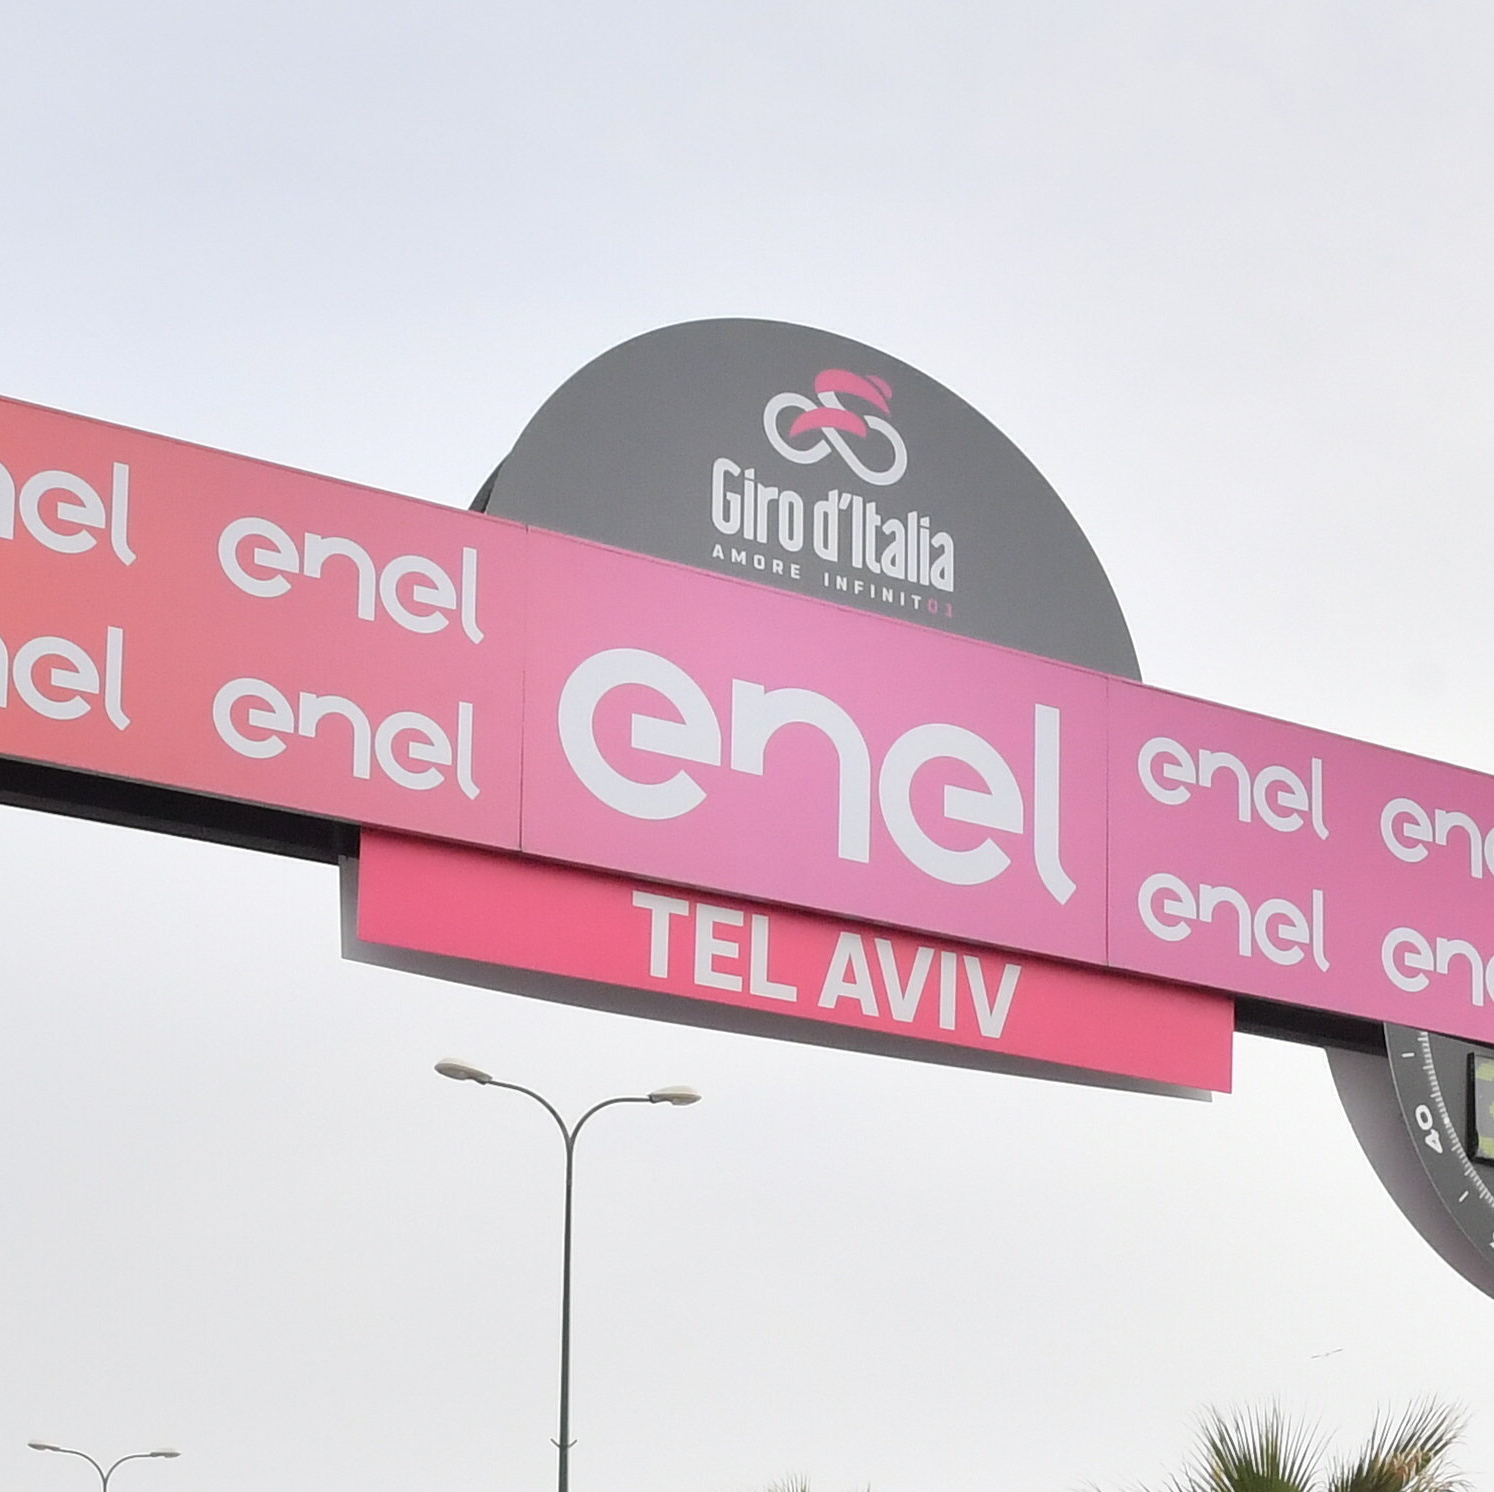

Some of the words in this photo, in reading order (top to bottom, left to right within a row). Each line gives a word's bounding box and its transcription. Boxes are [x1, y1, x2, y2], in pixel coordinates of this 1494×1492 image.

[712, 458, 804, 552] Giro
[219, 516, 485, 645] enel
[712, 543, 801, 580] AMORE
[212, 677, 481, 801] enel
[558, 647, 1077, 906] enel
[1138, 737, 1330, 840] enel
[632, 892, 797, 1002] TEL
[818, 933, 1022, 1039] AVIV
[1138, 873, 1330, 973] enel
[1415, 1104, 1444, 1154] 40
